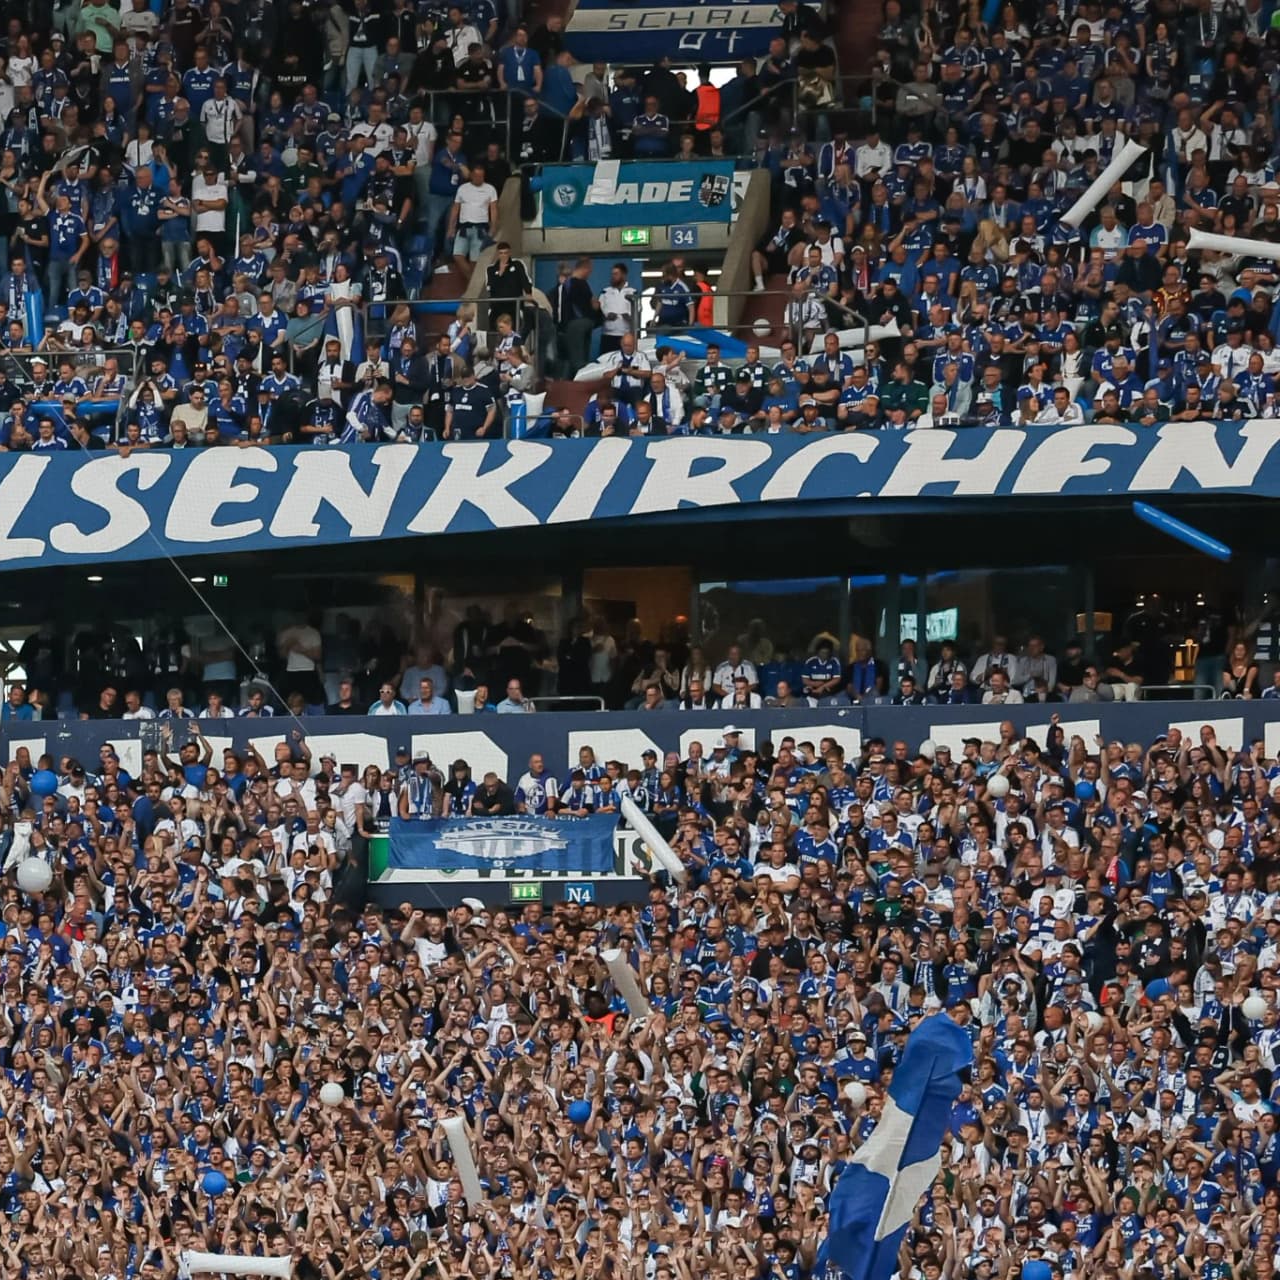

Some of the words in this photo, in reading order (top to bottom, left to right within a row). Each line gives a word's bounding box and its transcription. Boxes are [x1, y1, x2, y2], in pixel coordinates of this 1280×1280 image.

[607, 8, 786, 30] SCHALK
[674, 231, 694, 244] 34
[568, 887, 590, 902] N4
